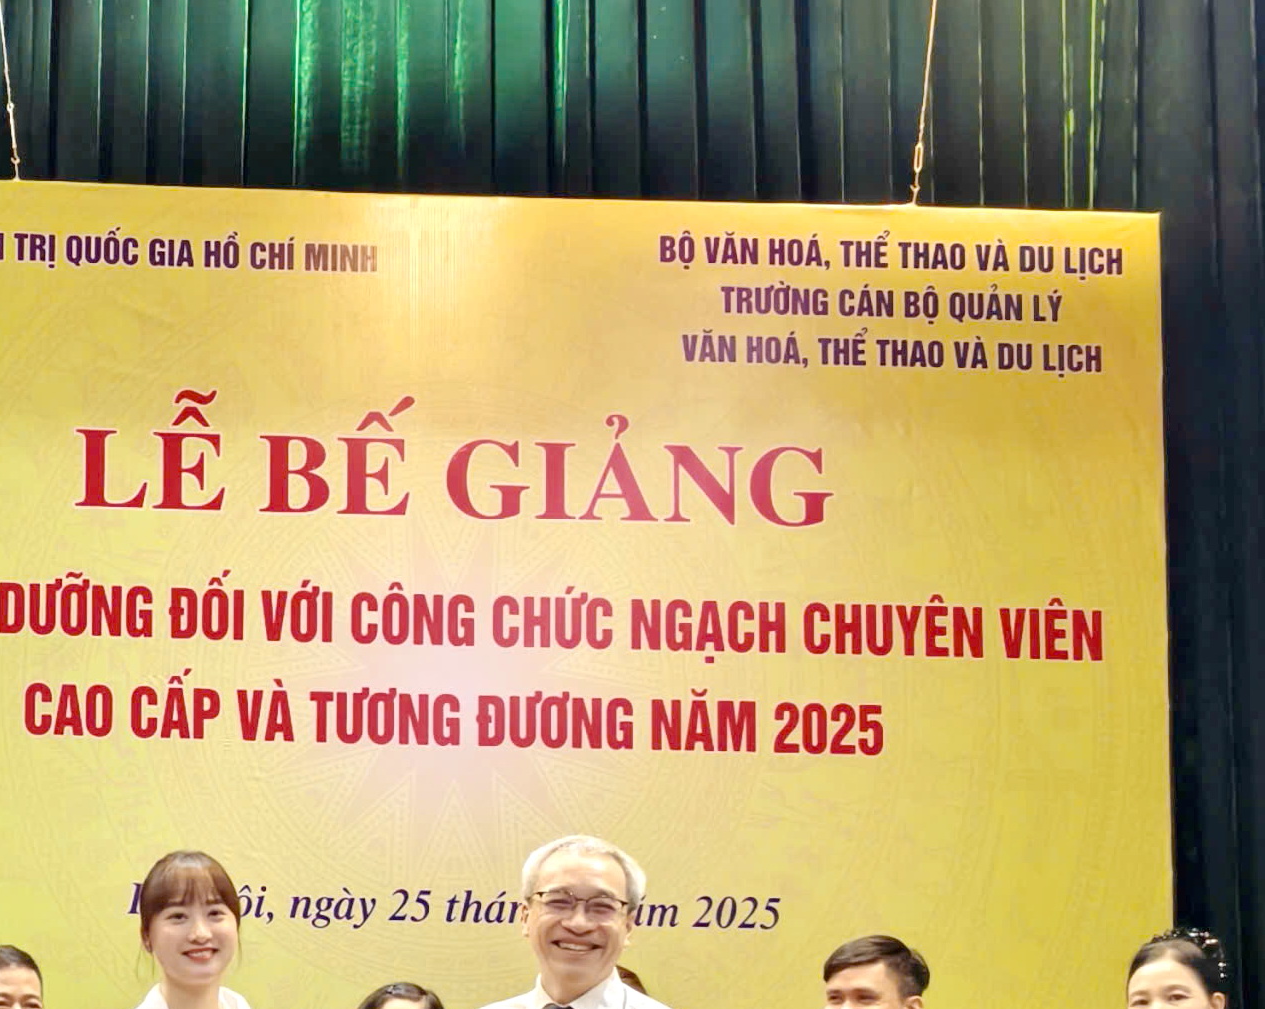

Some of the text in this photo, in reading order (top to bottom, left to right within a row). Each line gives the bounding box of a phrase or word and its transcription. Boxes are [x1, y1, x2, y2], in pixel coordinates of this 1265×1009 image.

[13, 232, 56, 269] TRỊ
[65, 230, 139, 267] QUỐC
[148, 238, 195, 268] GIA
[203, 235, 240, 269] HỒ
[249, 236, 295, 271] CHÍ
[305, 243, 378, 273] MINH
[659, 229, 1123, 281] BỘ VĂN HOÁ, THỂ THAO VÀ DU LỊCH
[720, 280, 1063, 325] TRƯỜNG CÁN BỘ QUẢN LÝ
[681, 326, 1102, 378] VĂN HOÁ, THỂ THAO VÀ DU LỊCH
[74, 389, 835, 528] LỄ BẾ GIẢNG
[168, 569, 245, 641] ĐỐI
[260, 579, 333, 643] VỚI
[350, 581, 475, 647] CÔNG
[492, 585, 613, 650] CHỨC
[630, 598, 787, 664] NGẠCH
[803, 593, 984, 659] CHUYÊN
[999, 597, 1103, 662] VIÊN
[24, 668, 884, 756] CAO CẤP VÀ TƯƠNG ĐƯƠNG NĂM 2025
[289, 887, 377, 930] ngày
[388, 888, 432, 923] 25
[692, 895, 781, 930] 2025
